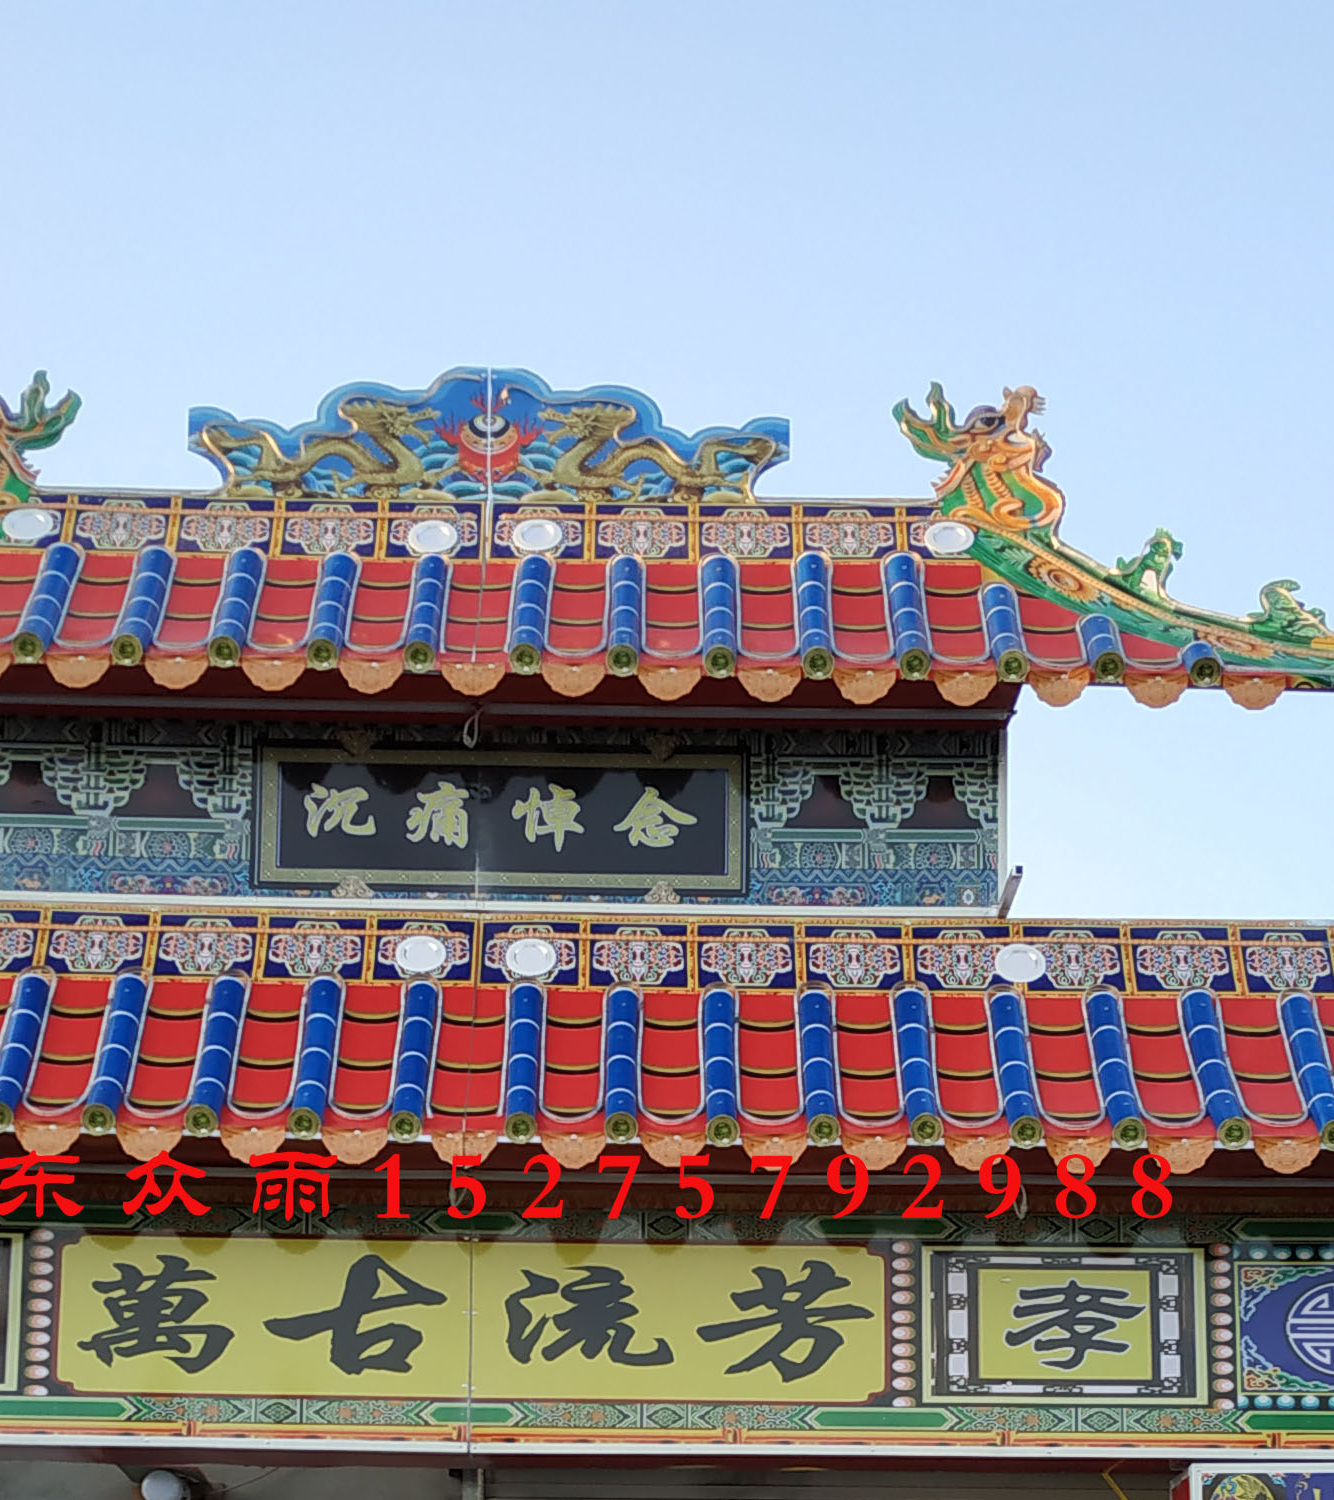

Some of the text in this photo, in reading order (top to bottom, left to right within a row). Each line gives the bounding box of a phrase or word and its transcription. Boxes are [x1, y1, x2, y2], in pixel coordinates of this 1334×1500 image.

[303, 782, 698, 852] 沉痛悼念
[77, 1254, 875, 1383] 萬古流芳
[1004, 1278, 1147, 1371] 孝
